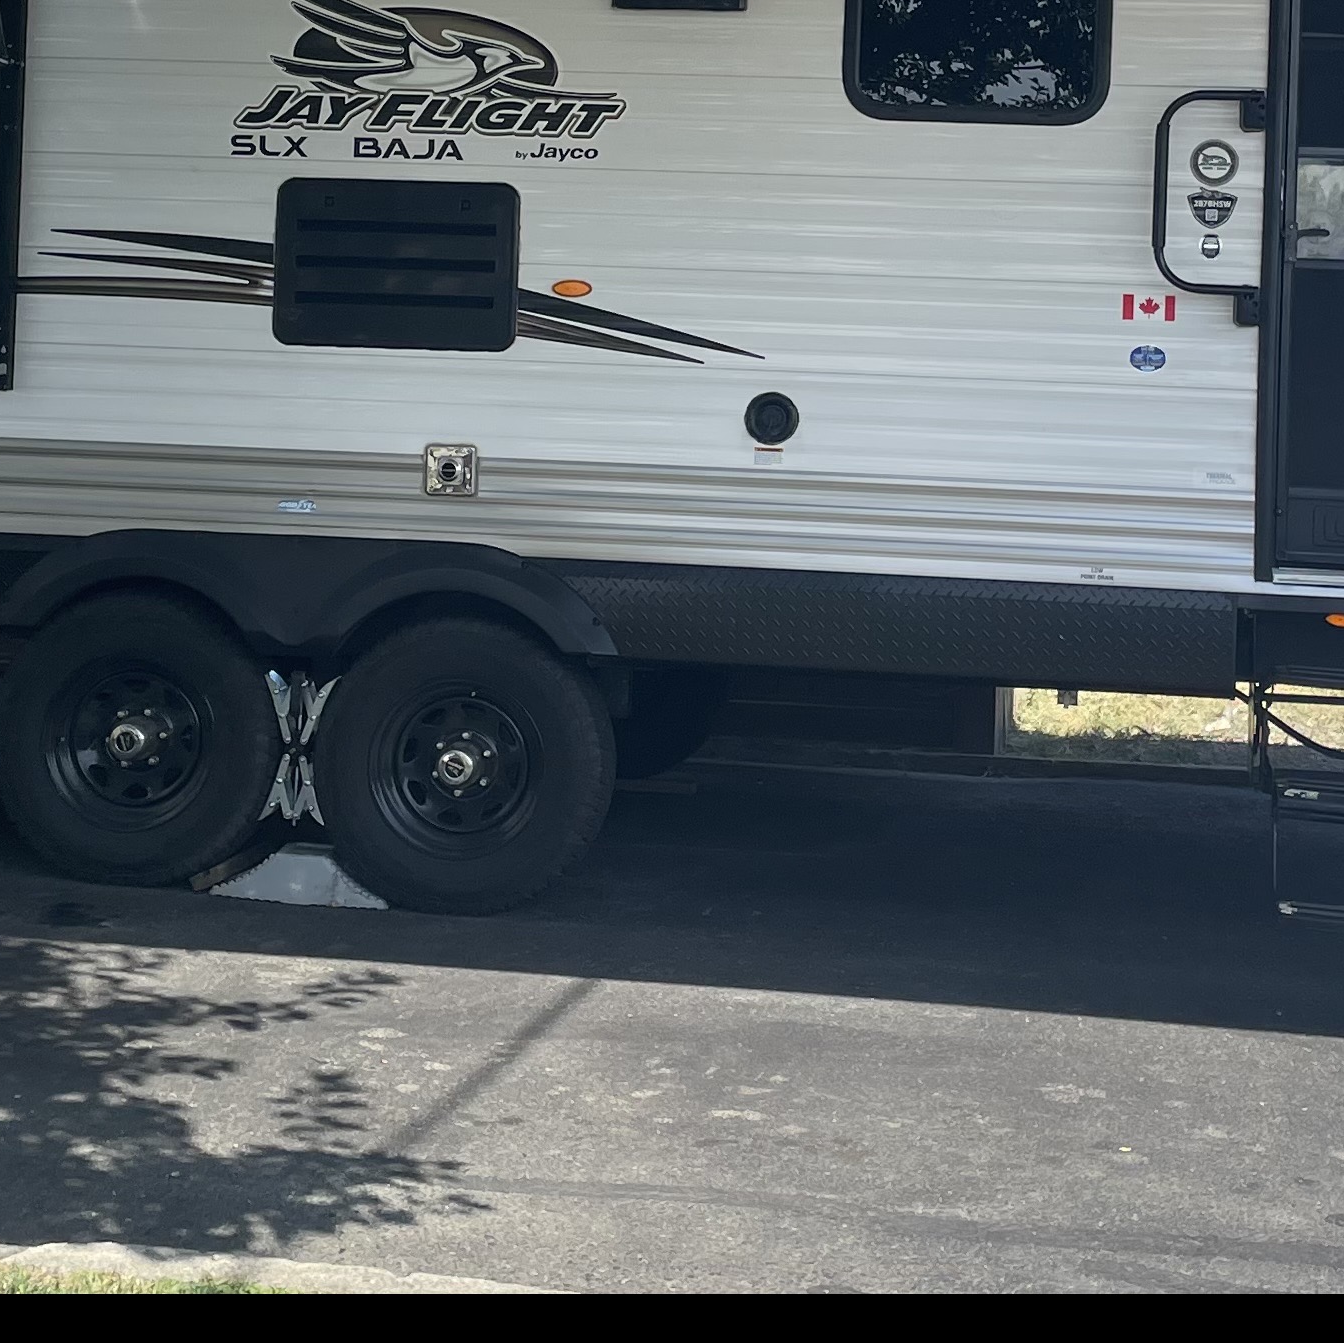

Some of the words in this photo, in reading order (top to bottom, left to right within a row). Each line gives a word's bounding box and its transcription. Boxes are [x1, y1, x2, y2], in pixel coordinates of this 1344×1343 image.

[235, 86, 378, 130] JAY
[364, 90, 626, 138] FLIGHT
[230, 135, 308, 157] SLX
[354, 137, 464, 160] BAJA
[515, 150, 529, 160] by
[530, 142, 599, 161] Jayco
